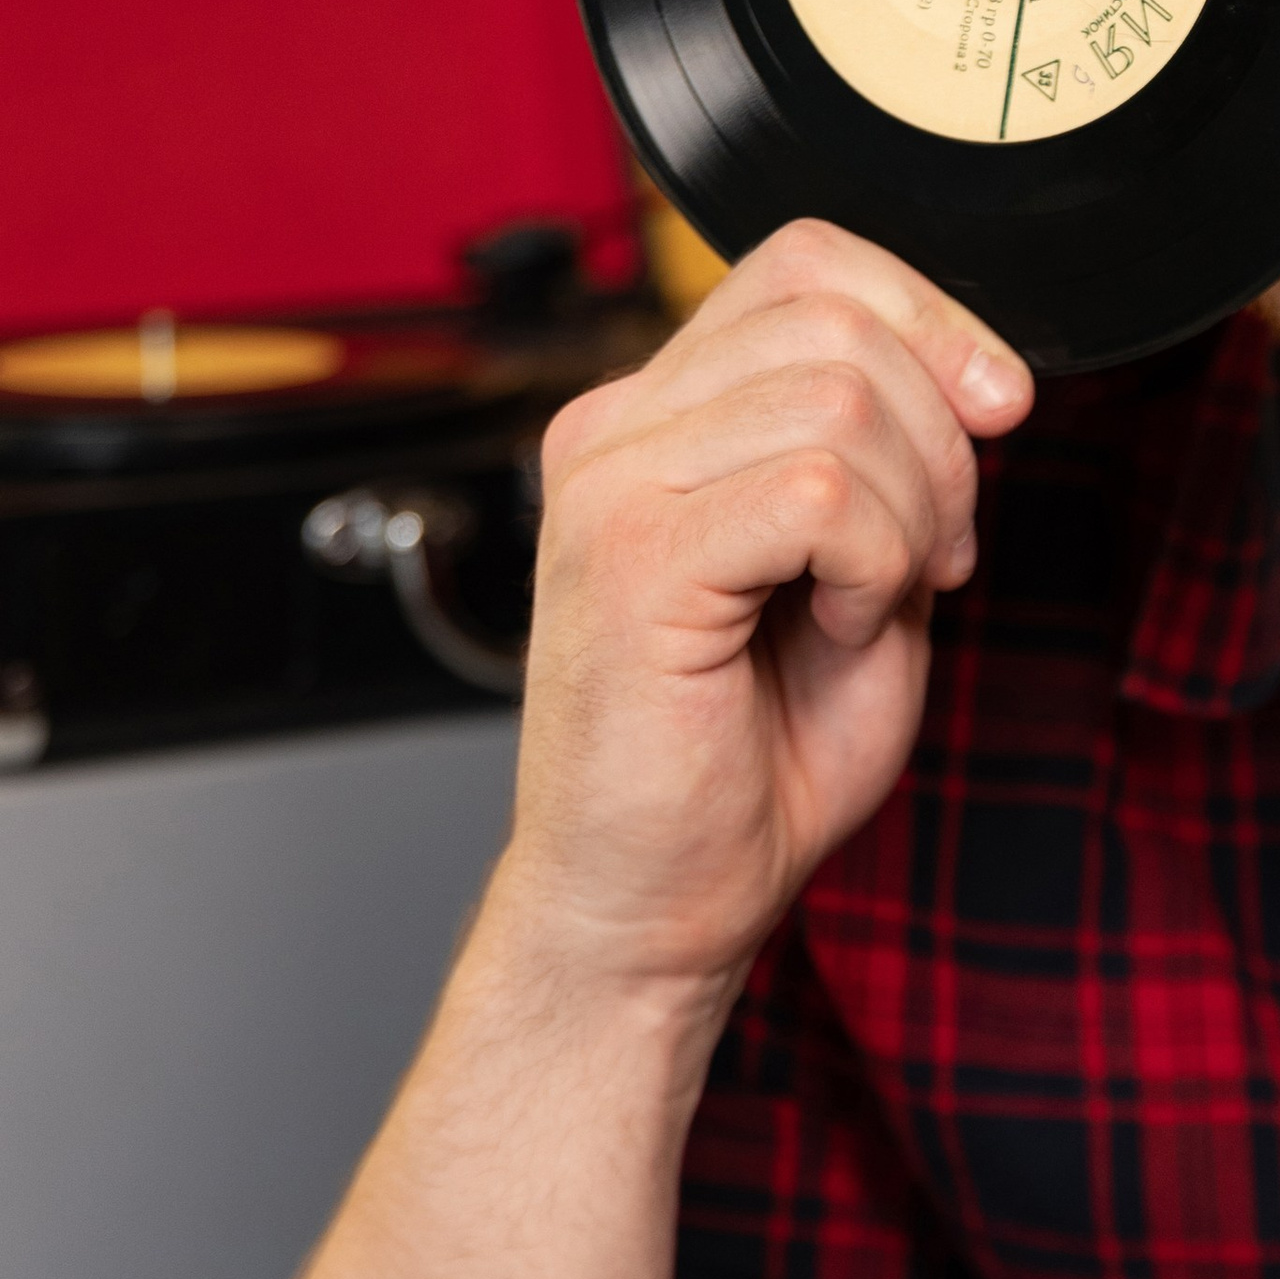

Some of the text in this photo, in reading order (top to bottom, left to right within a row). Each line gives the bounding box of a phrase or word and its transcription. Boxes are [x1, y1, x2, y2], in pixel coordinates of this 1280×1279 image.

[980, 8, 997, 27] гр
[976, 31, 996, 69] 0-70
[953, 63, 967, 72] 2
[1034, 67, 1053, 88] 33
